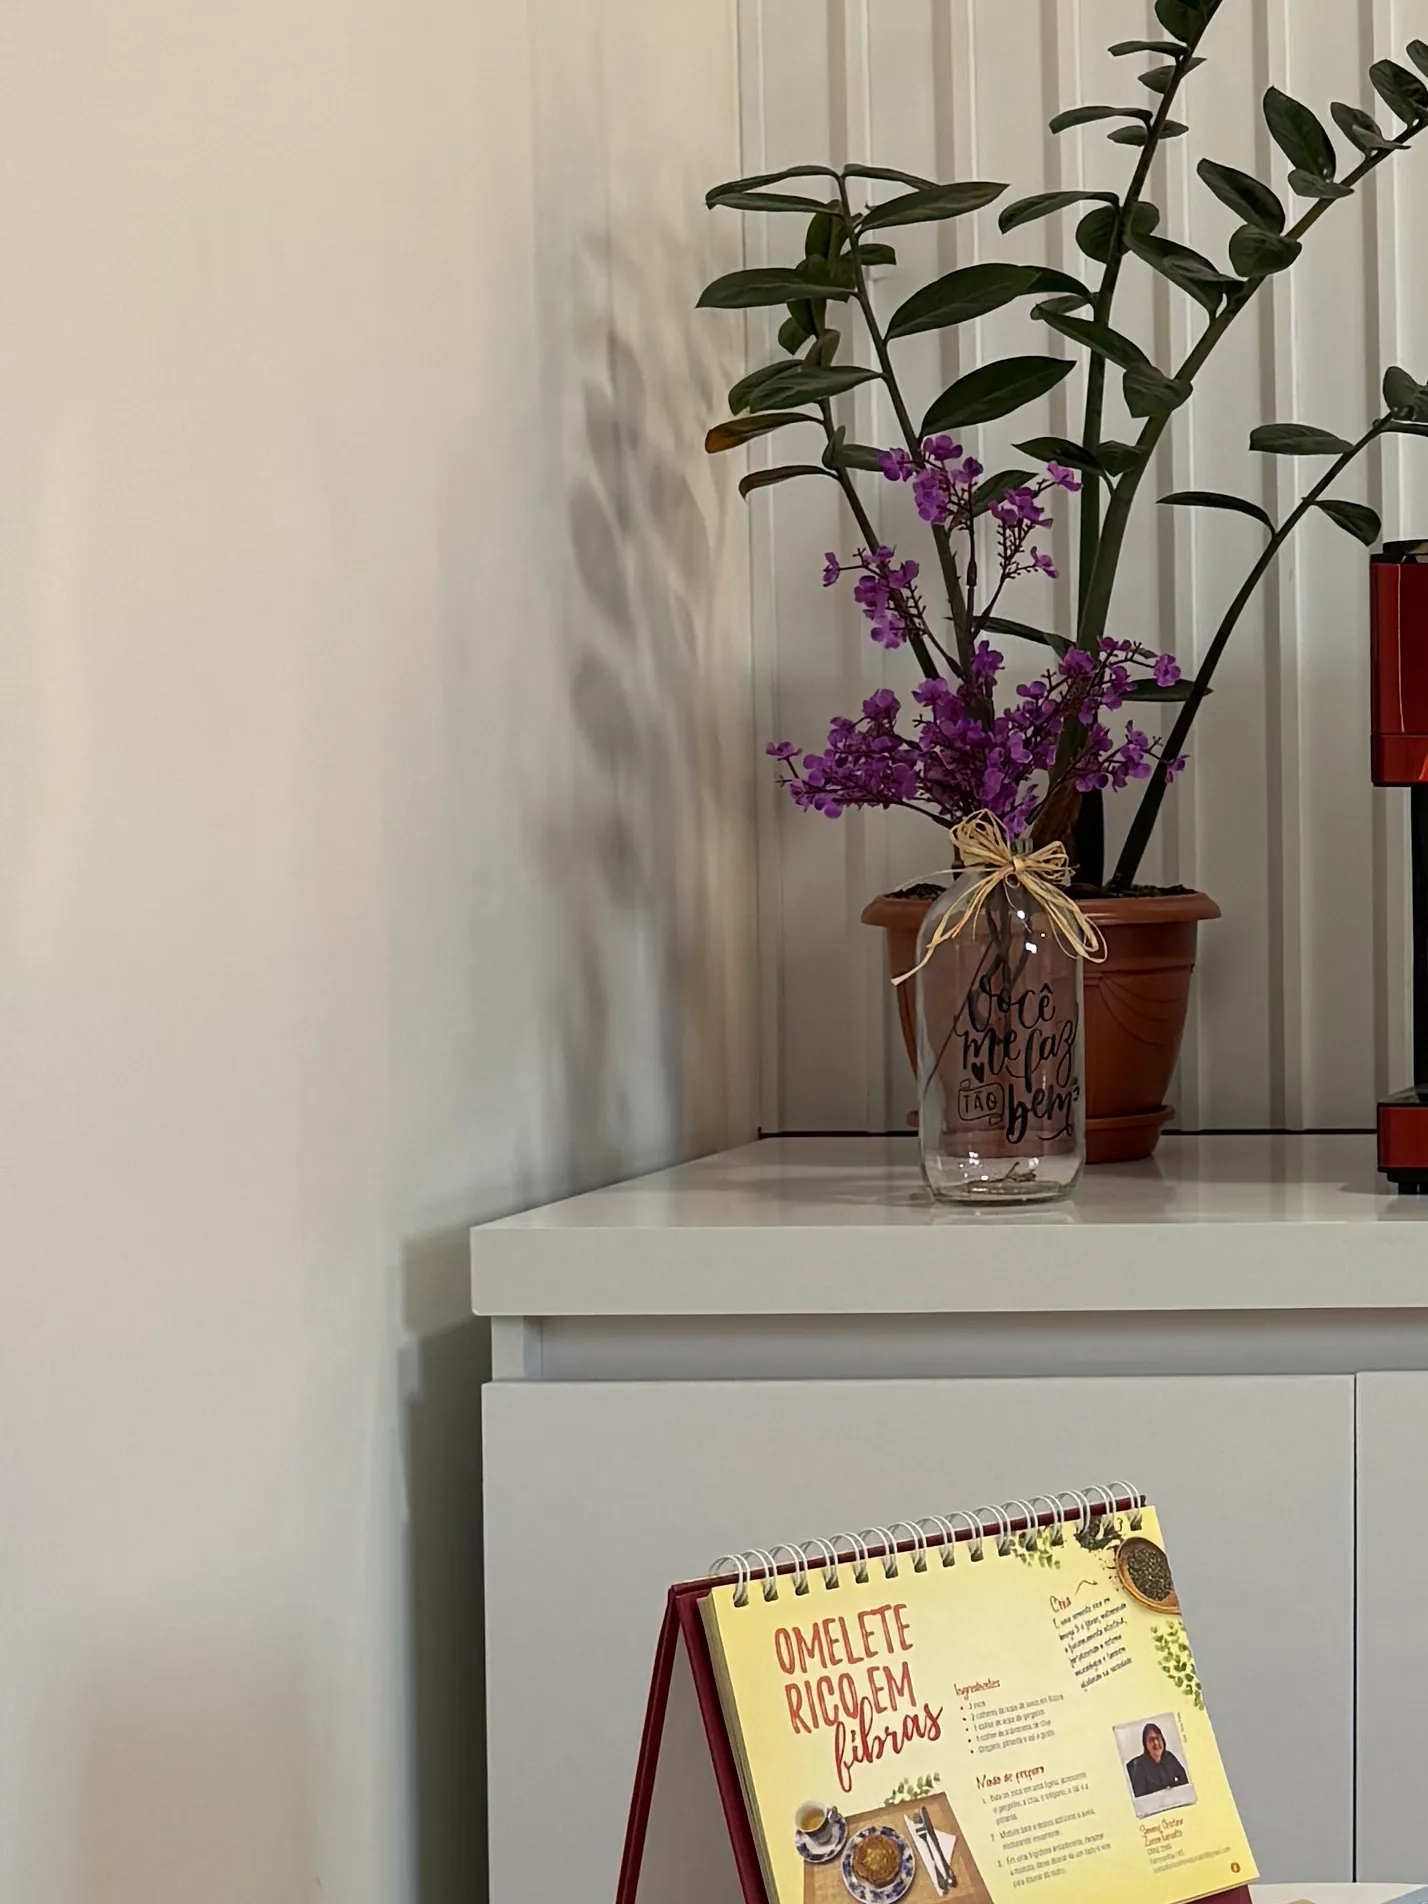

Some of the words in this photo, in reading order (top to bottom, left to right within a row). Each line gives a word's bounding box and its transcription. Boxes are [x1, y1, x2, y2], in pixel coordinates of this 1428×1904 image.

[968, 974, 1056, 1033] Você
[954, 1027, 1022, 1076] me
[1006, 1003, 1079, 1093] faz
[963, 1089, 999, 1114] TÃO
[774, 1603, 914, 1675] OMELETE
[784, 1672, 859, 1735] RICO
[866, 1661, 917, 1715] EM
[834, 1695, 944, 1793] fibras
